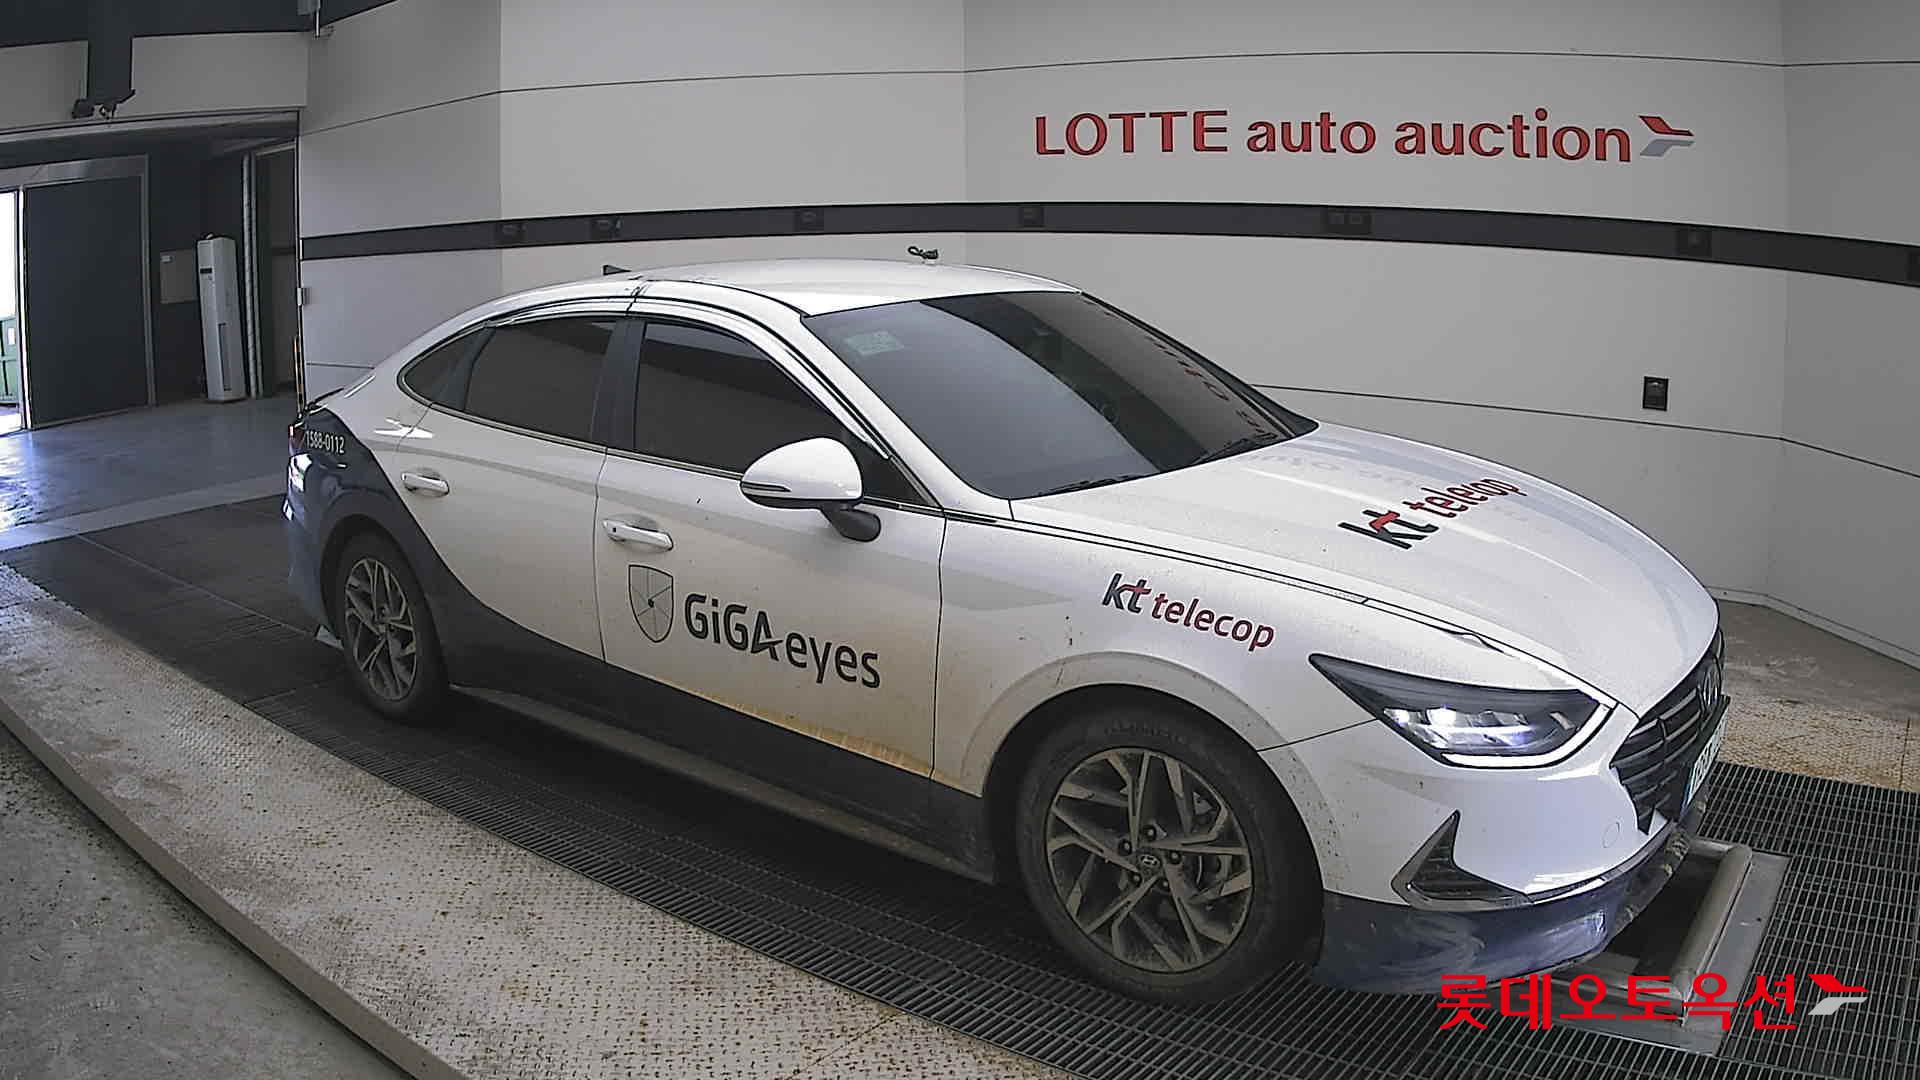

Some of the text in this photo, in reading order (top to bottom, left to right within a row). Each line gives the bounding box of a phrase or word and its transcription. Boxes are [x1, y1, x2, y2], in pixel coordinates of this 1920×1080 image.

[1035, 107, 1632, 162] LOTTE auto auction
[304, 429, 345, 454] 1588-0112
[1337, 478, 1528, 550] kt telecop
[1102, 572, 1275, 652] kt telecop
